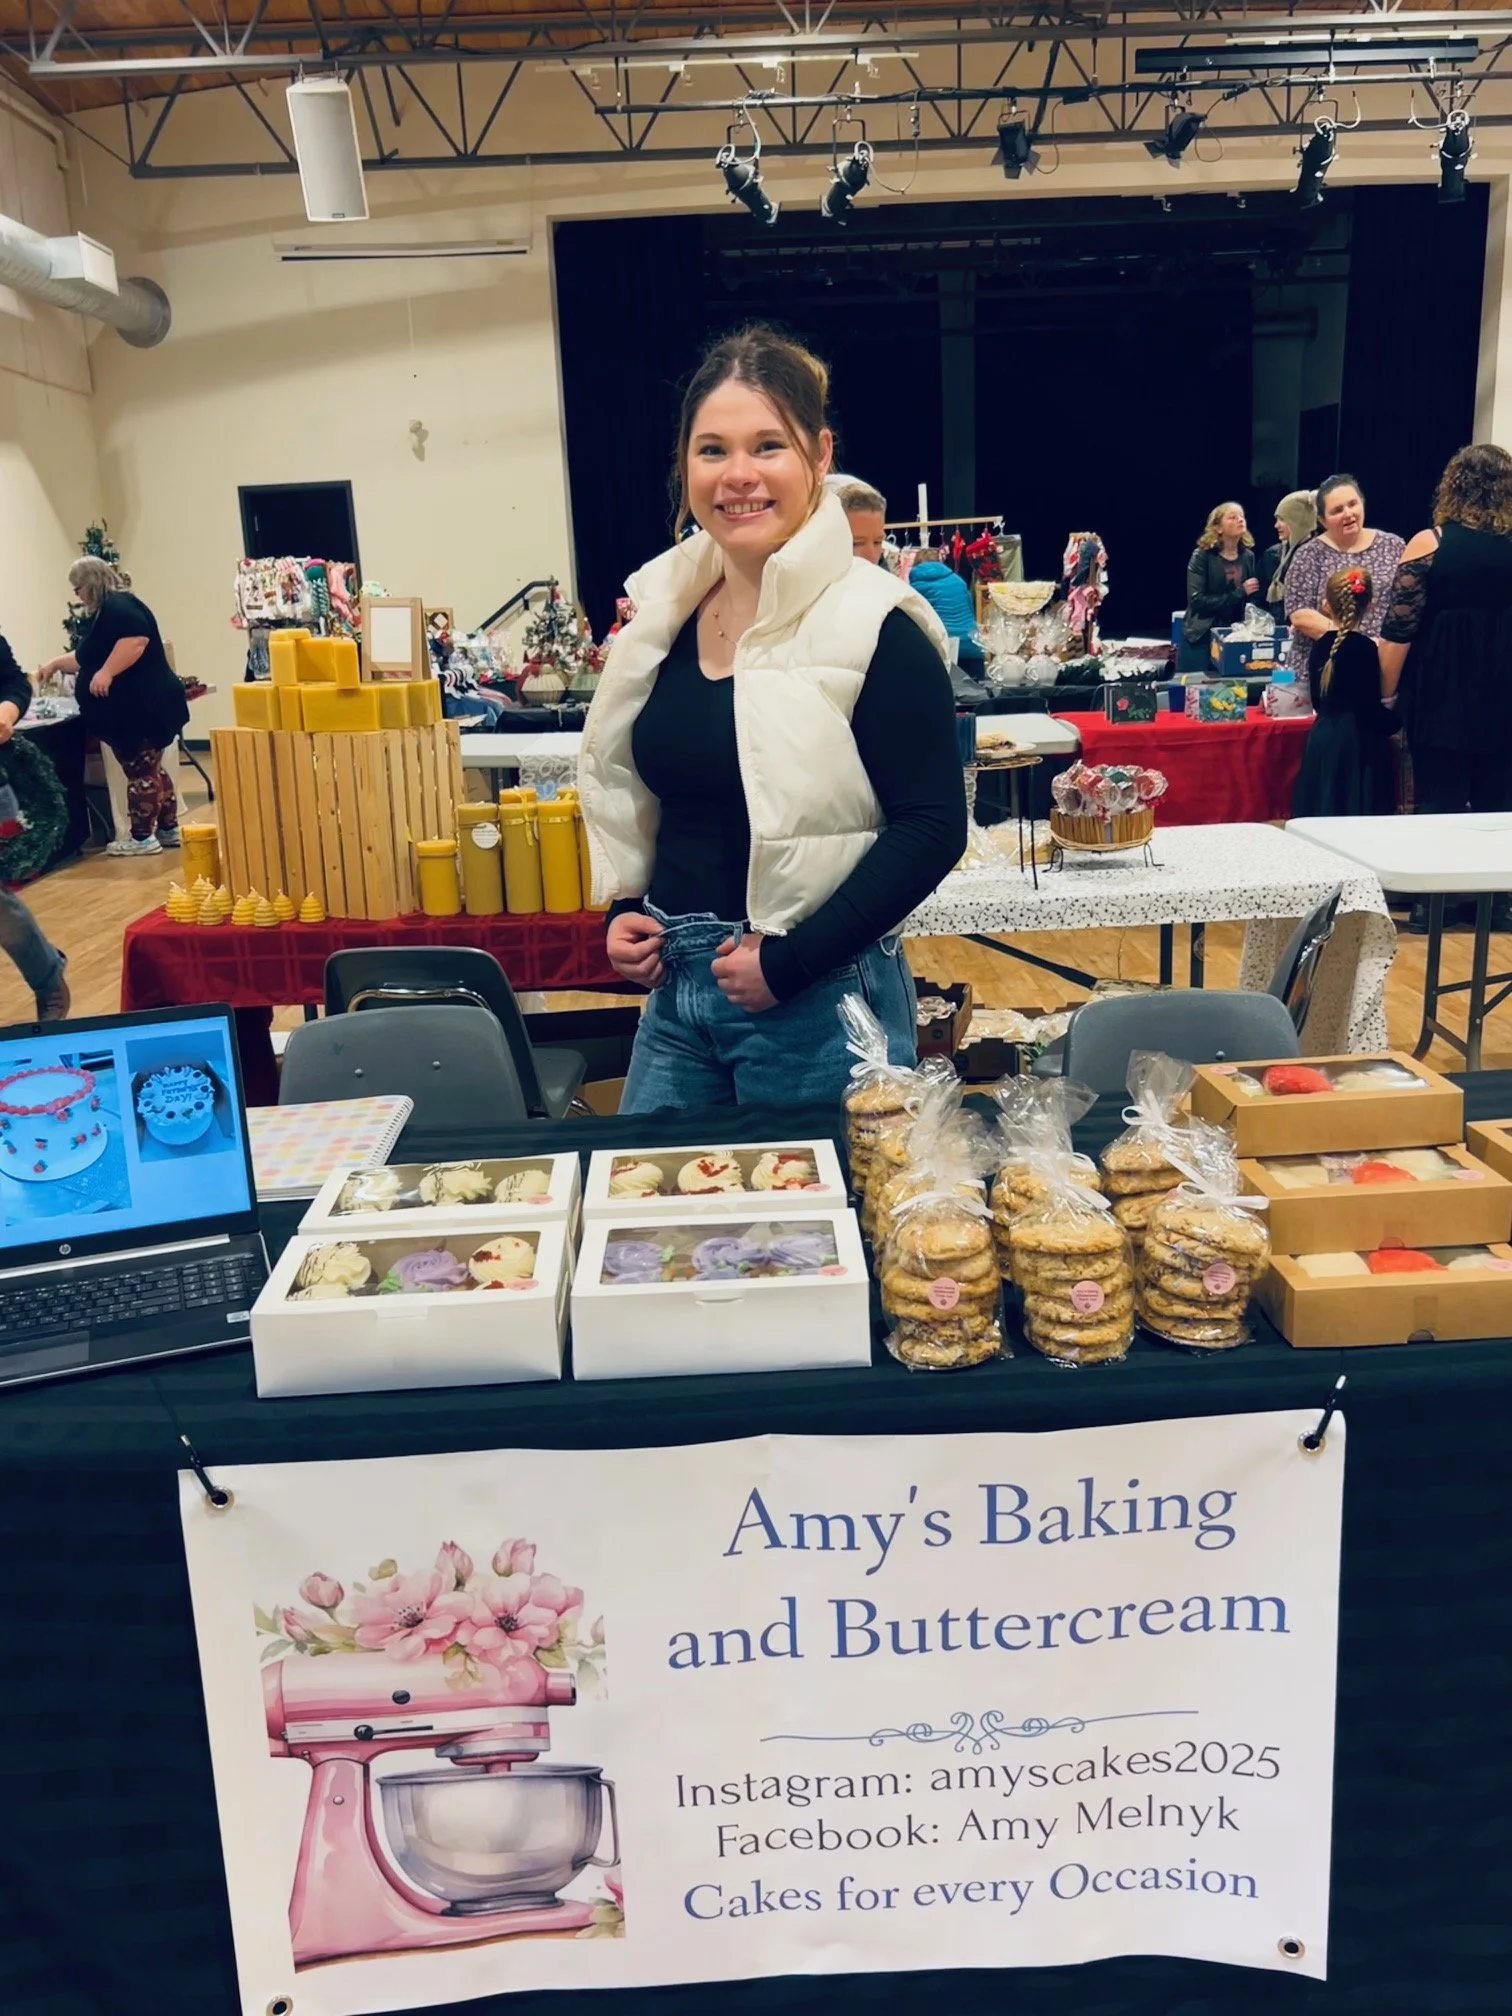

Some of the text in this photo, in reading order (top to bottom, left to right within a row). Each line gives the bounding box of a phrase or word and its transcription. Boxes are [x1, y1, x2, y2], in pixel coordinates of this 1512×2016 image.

[722, 1477, 1238, 1577] Amy's Baking
[668, 1594, 1290, 1669] and Buttercream
[676, 1741, 1281, 1808] Instagram: amyscakes2025
[717, 1794, 1240, 1858] Facebook: Amy Melnyk
[683, 1857, 1259, 1920] Cakes for every Occasion
